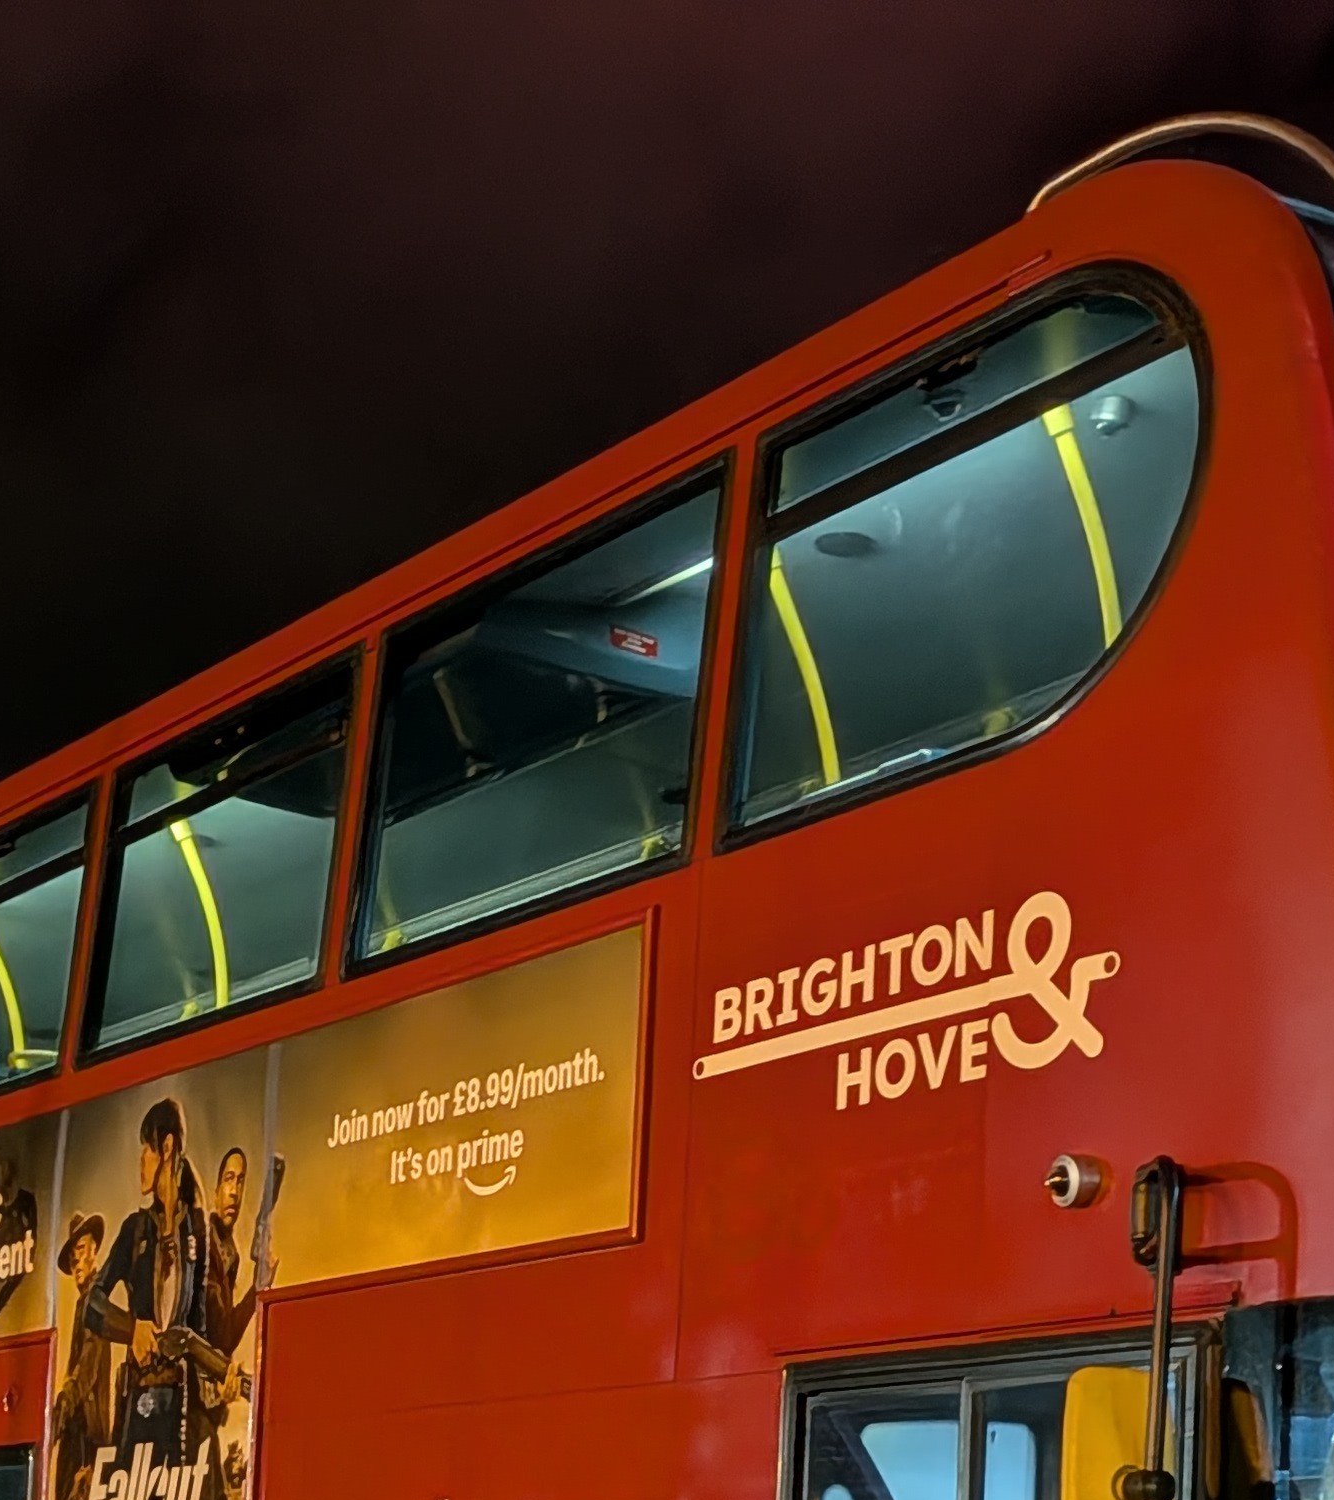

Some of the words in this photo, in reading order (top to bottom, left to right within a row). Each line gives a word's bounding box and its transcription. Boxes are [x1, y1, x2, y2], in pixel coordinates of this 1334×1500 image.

[712, 909, 995, 1044] BRIGHTON
[326, 1107, 368, 1150] Join
[371, 1105, 413, 1139] now
[415, 1090, 450, 1125] for
[452, 1046, 606, 1117] £8.99/month.
[835, 1018, 989, 1111] HOVE
[389, 1148, 424, 1184] It's
[426, 1146, 455, 1176] on
[456, 1127, 524, 1178] prime
